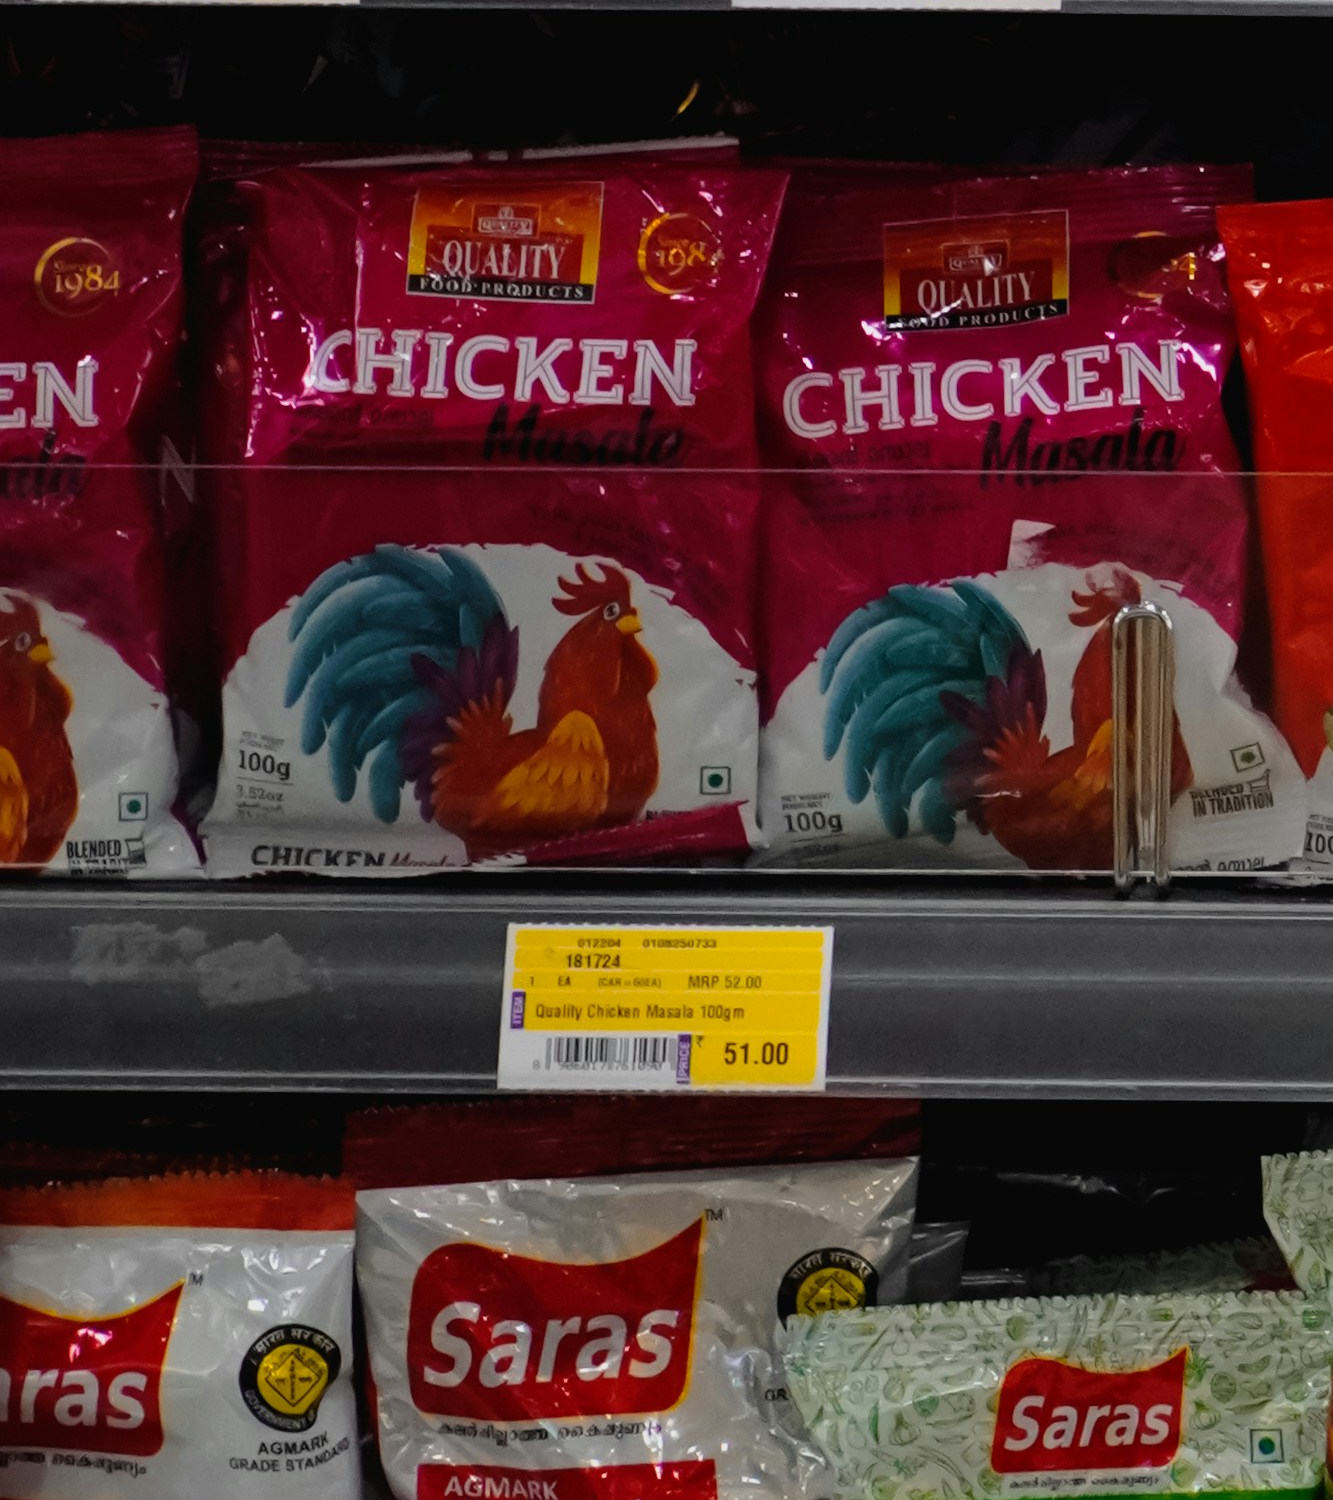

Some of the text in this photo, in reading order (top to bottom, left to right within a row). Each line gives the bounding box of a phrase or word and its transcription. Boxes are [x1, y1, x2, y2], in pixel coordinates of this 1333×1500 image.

[311, 327, 698, 406] CHICKEN
[784, 338, 1185, 438] CHICKEN
[484, 405, 688, 464] Masala
[238, 749, 292, 782] 100g
[567, 954, 621, 968] 181724
[689, 976, 762, 988] MRP 52.00
[536, 1004, 744, 1021] Quality Chicken Masala 100gm
[724, 1042, 789, 1065] 51.00
[422, 1299, 681, 1391] Saras
[258, 1433, 331, 1456] AGMARK
